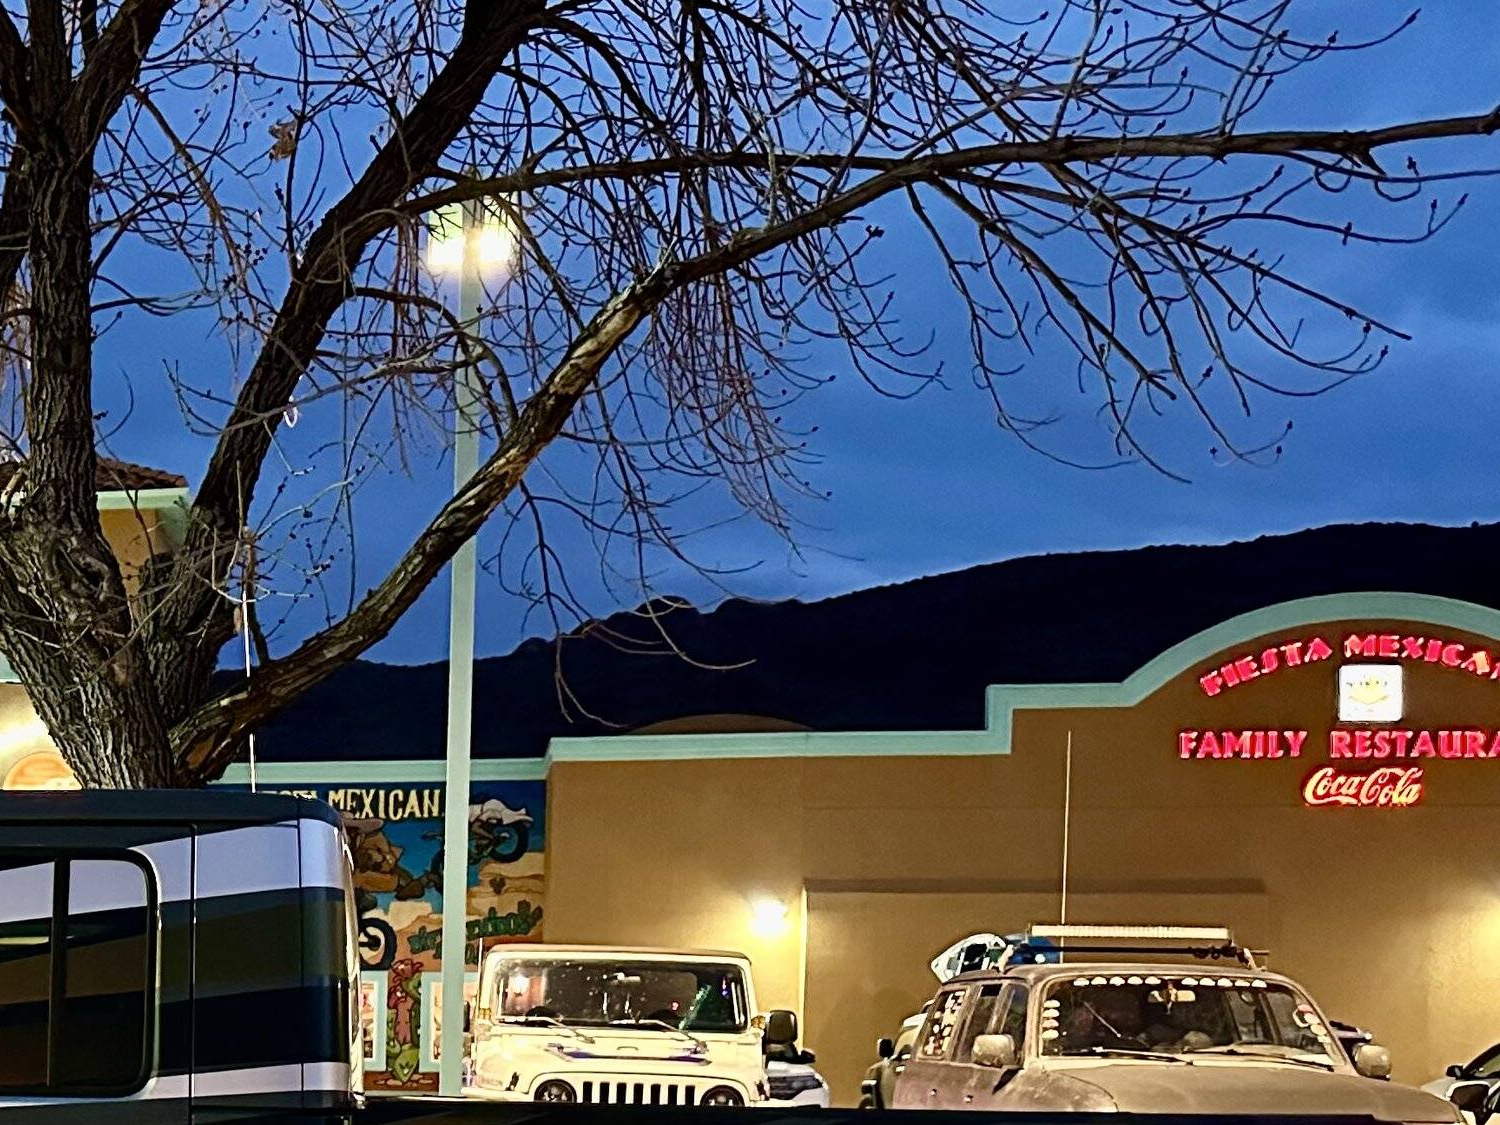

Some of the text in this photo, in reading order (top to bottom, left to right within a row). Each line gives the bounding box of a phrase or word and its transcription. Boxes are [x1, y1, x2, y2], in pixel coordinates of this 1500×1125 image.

[1200, 637, 1333, 696] FIESTA
[1178, 730, 1308, 759] FAMILY
[328, 788, 446, 821] MEXICAN
